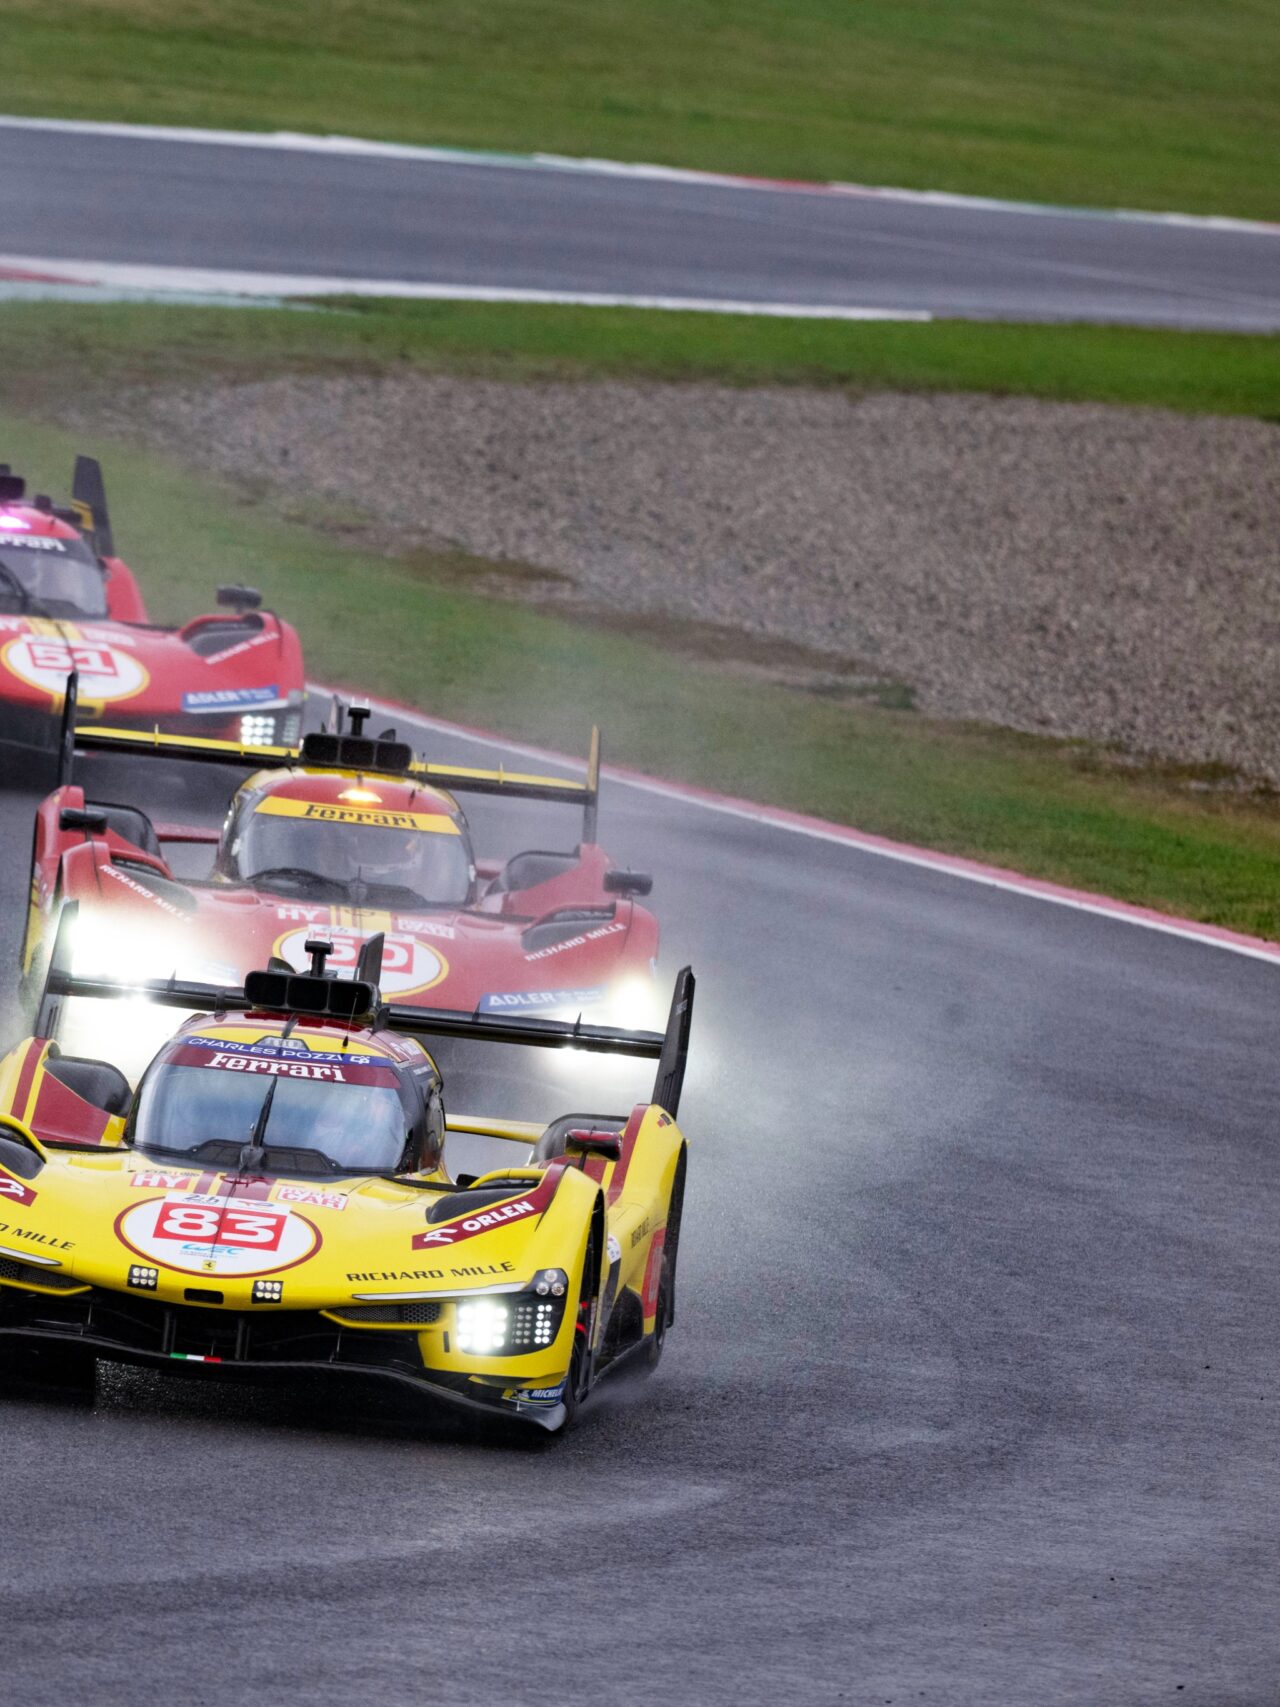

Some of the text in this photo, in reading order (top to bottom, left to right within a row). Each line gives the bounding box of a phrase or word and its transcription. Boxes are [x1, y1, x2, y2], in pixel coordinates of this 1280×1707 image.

[30, 644, 114, 673] 51
[303, 804, 420, 828] Ferrari
[99, 864, 154, 898] RICHARD
[277, 908, 320, 921] HY
[524, 923, 627, 961] RICHARD MILLE
[488, 992, 556, 1006] ADLER
[188, 1038, 277, 1055] CHARLES
[282, 1050, 343, 1062] POZZI
[204, 1052, 346, 1082] Ferrari
[133, 1173, 185, 1188] HY
[282, 1192, 340, 1209] CAR
[162, 1208, 278, 1244] 83
[462, 1201, 535, 1231] ORLEN
[10, 1228, 76, 1250] MILLE
[346, 1261, 516, 1282] RICHARD MILLE
